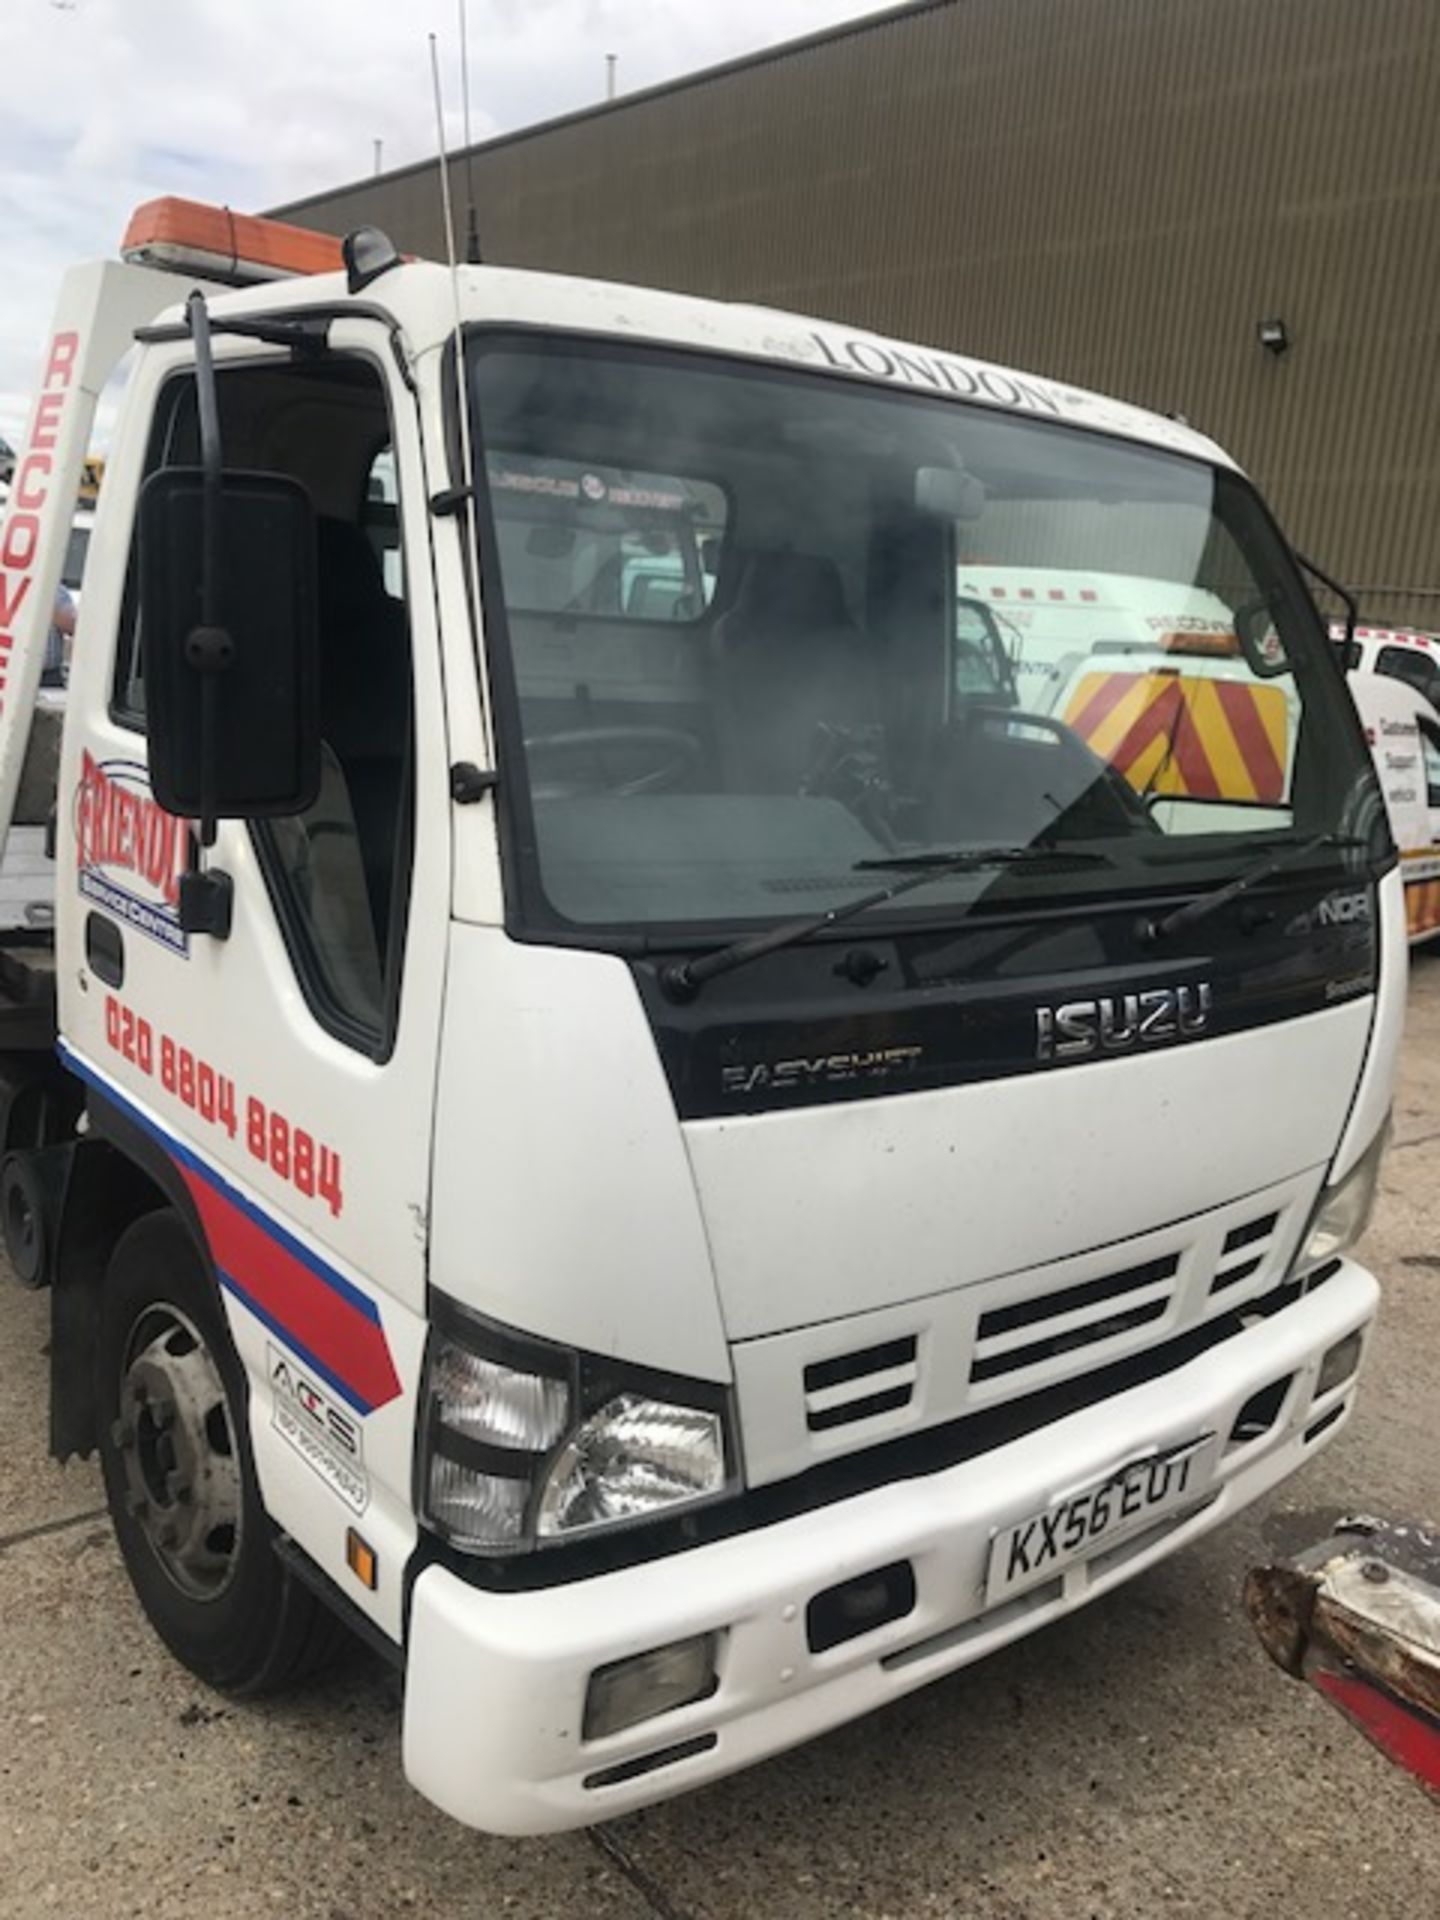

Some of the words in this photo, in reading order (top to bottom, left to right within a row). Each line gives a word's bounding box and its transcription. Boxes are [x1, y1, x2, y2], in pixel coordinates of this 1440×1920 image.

[811, 331, 1060, 416] LONDON
[1035, 983, 1211, 1061] ISUZU
[105, 994, 153, 1077] 020
[161, 1033, 237, 1140] 8804
[246, 1094, 343, 1219] 8884
[1006, 1483, 1114, 1583] KX56
